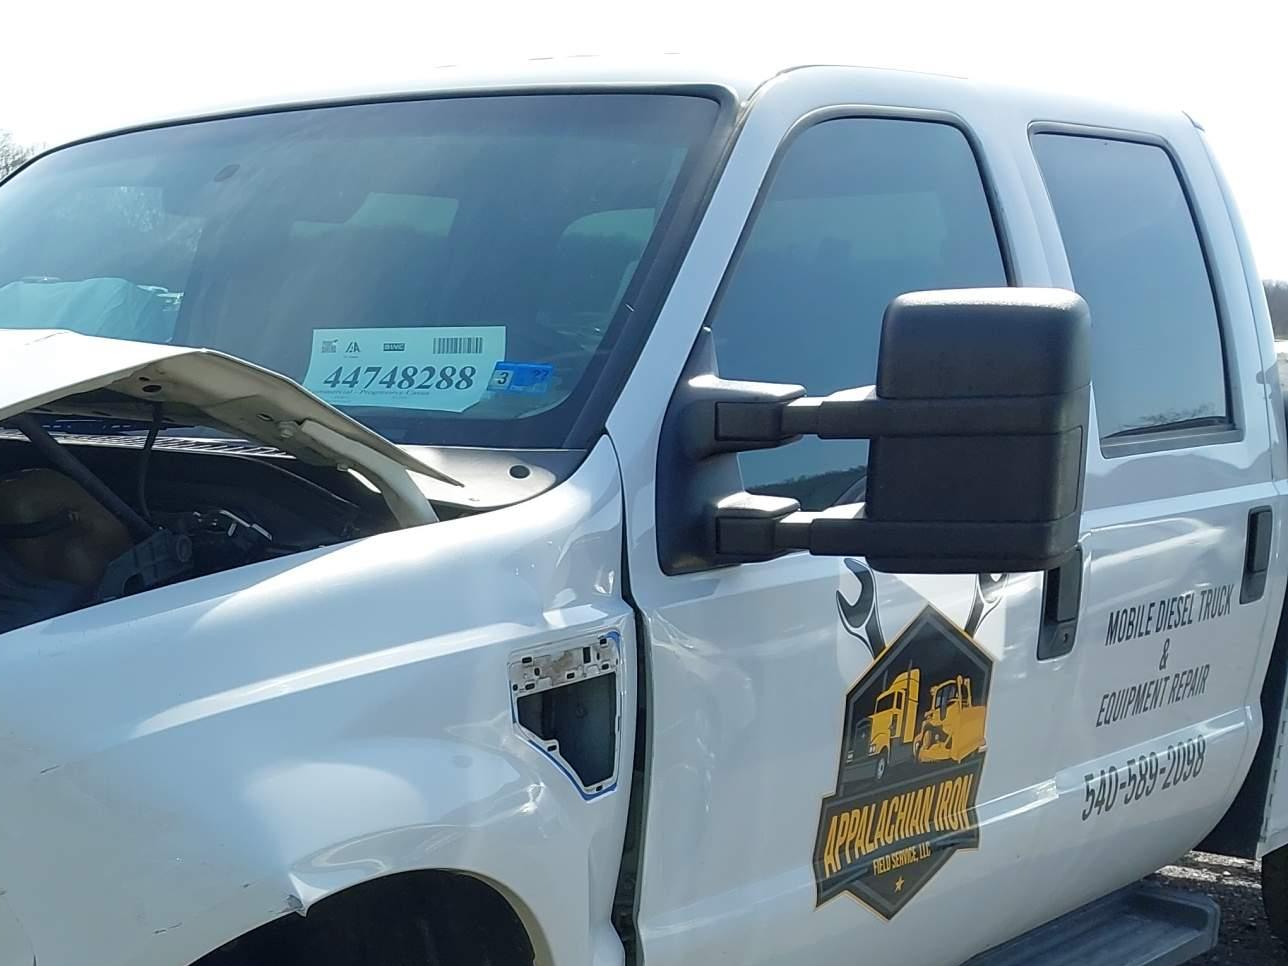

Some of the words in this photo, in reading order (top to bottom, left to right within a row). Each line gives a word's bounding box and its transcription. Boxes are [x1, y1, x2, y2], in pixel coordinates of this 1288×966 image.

[323, 365, 477, 390] 44748288
[498, 371, 509, 385] 3
[1105, 602, 1156, 646] MOBILE
[1155, 592, 1194, 633] DIESEL
[1198, 584, 1235, 622] TRUCK
[1159, 638, 1170, 671] &
[1095, 677, 1170, 728] EQUIPMENT
[1168, 664, 1211, 705] REPAIR
[1082, 734, 1207, 822] 540-589-2098
[824, 784, 936, 879] APPALACHIAN
[934, 774, 975, 832] IRON
[873, 857, 892, 876] FIELD
[891, 848, 920, 869] SERVICE,
[919, 841, 931, 859] LLC
